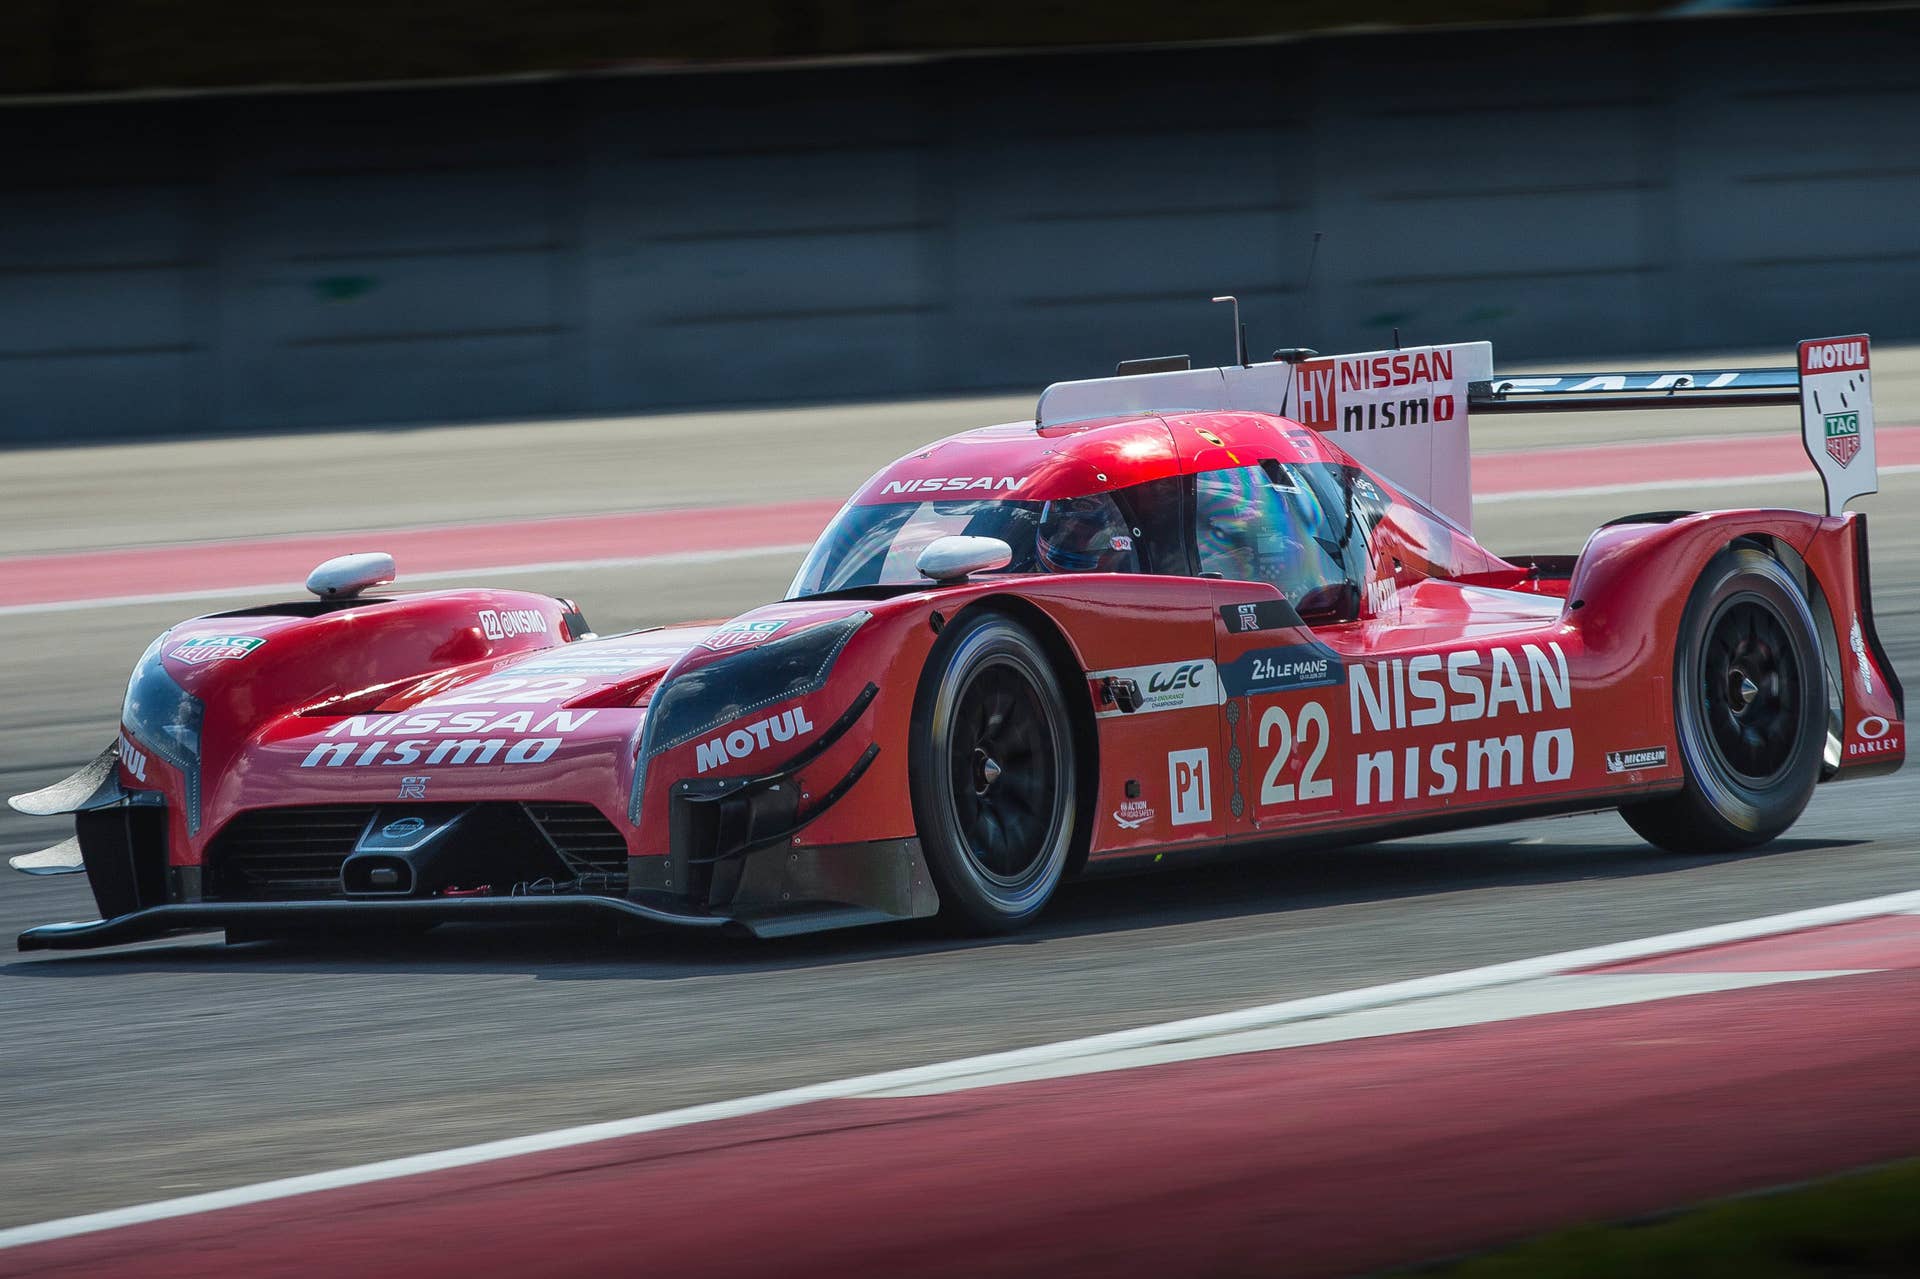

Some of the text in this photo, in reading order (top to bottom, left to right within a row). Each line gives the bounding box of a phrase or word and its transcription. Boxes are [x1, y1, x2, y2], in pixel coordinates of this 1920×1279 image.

[1807, 341, 1864, 369] MOTUL
[1341, 350, 1453, 392] NISSAN
[1344, 395, 1454, 432] nismo
[1827, 415, 1856, 434] TAG
[1826, 439, 1859, 465] HEUER
[881, 476, 1027, 495] NISSAN
[501, 610, 547, 637] @NISMO
[176, 646, 244, 662] HEUER
[191, 637, 253, 649] TAG
[1148, 665, 1203, 693] WEC
[1277, 664, 1292, 677] LE
[1293, 659, 1328, 675] MANS
[1349, 641, 1571, 734] NISSAN
[325, 711, 598, 737] NISSAN
[300, 737, 562, 767] nismo
[696, 706, 813, 773] MOTUL
[1849, 737, 1898, 755] OAKLEY
[1258, 702, 1333, 805] 22
[1356, 727, 1574, 806] nismo
[1624, 750, 1666, 764] MICHELIN
[1175, 758, 1205, 814] P1
